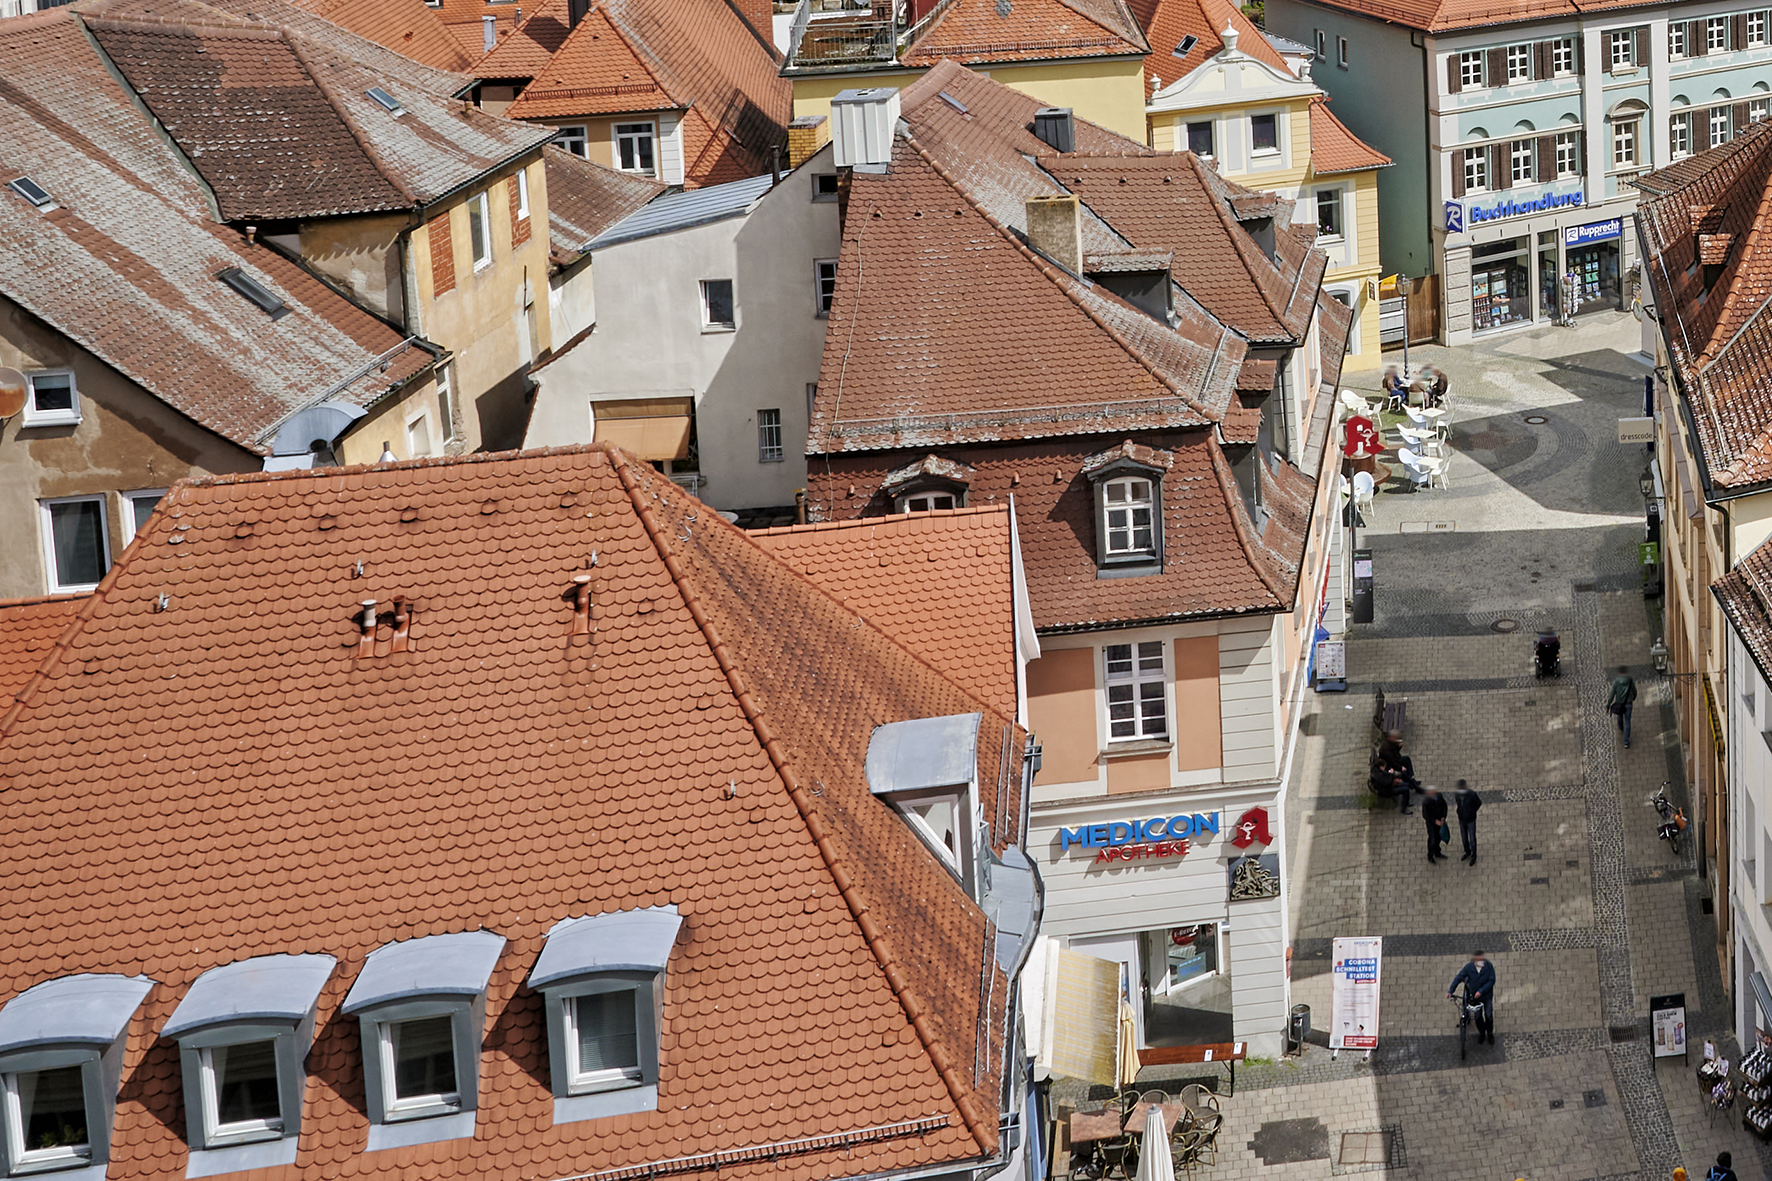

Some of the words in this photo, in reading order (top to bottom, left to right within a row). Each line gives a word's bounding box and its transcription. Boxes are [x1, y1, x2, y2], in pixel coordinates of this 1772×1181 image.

[1447, 205, 1462, 229] R
[1472, 192, 1582, 222] Buchhandlung
[1579, 220, 1620, 238] Rupprecht
[1620, 432, 1653, 440] dresscode
[1060, 810, 1220, 851] MEDICON
[1095, 839, 1190, 865] APOTHEKE
